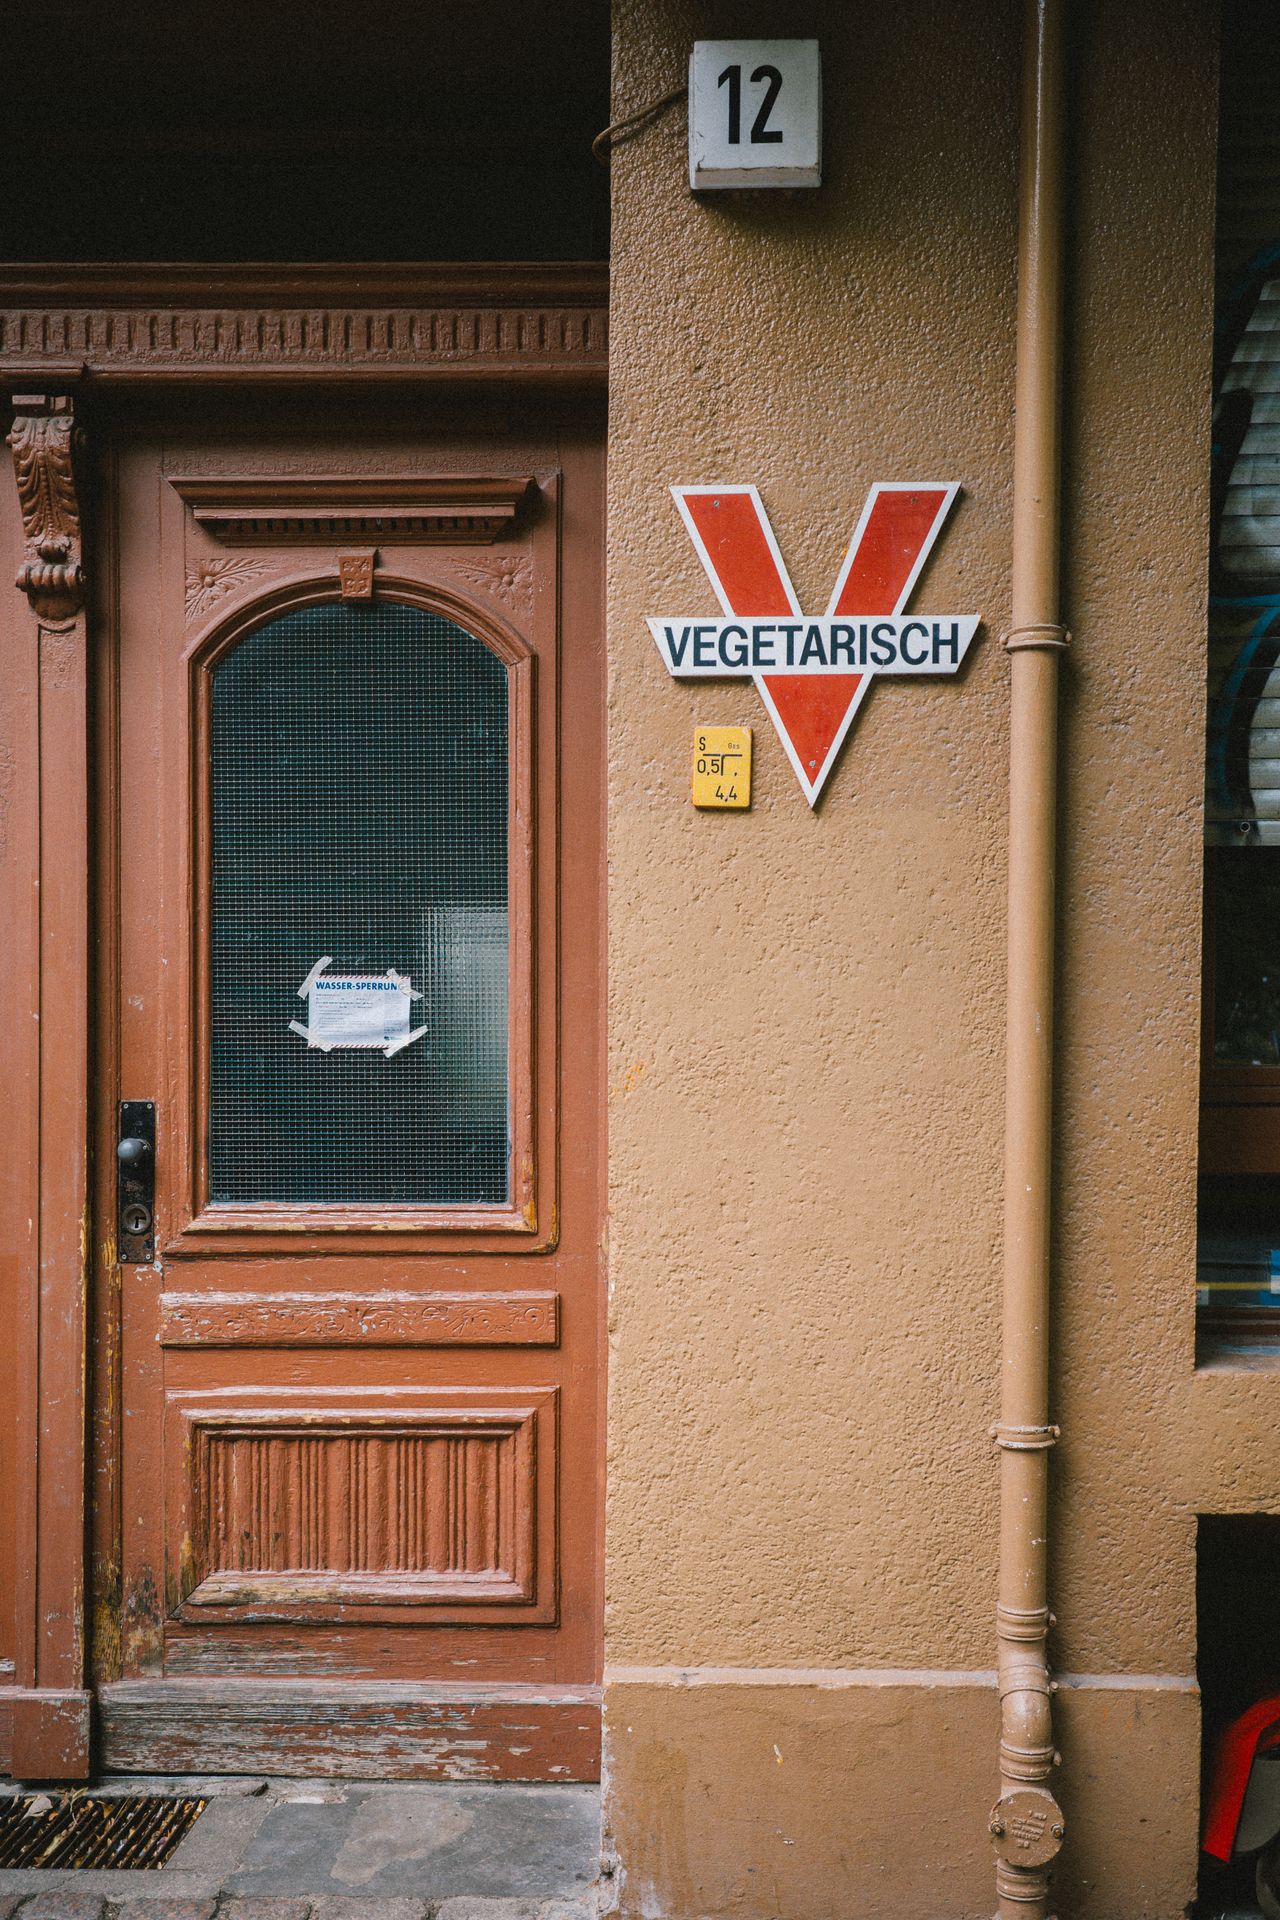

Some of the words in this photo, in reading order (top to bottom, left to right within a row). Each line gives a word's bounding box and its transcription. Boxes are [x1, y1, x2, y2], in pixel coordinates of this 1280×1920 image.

[718, 64, 783, 145] 12
[663, 622, 959, 667] VEGETARISCH
[699, 736, 706, 751] S
[697, 759, 720, 776] 0,5
[715, 785, 737, 802] 4,4
